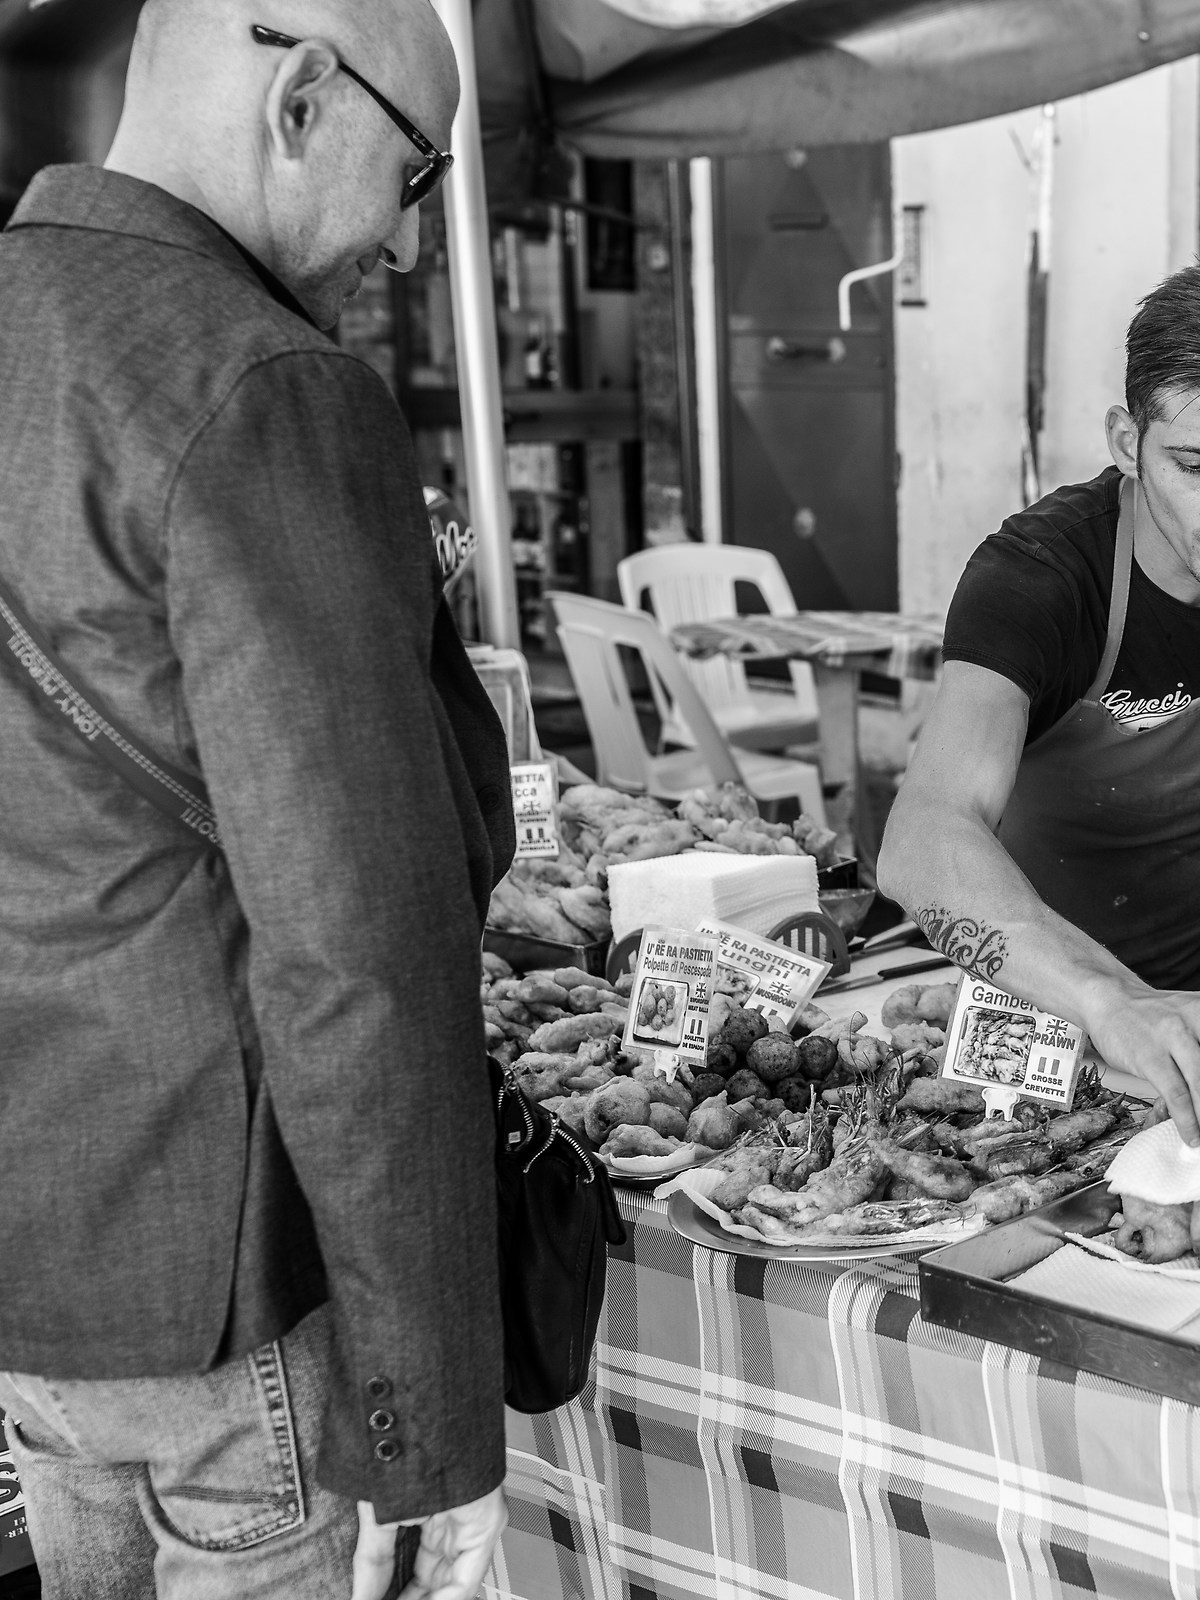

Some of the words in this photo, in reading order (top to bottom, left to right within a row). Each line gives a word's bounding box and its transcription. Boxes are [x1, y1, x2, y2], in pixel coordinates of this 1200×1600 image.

[666, 945, 677, 958] RA
[679, 947, 713, 962] PASTIETTA
[719, 944, 790, 979] unghi
[731, 940, 748, 952] RA
[749, 947, 811, 977] PASTIETTA
[643, 957, 669, 973] Polpette
[670, 960, 678, 973] di
[755, 987, 798, 1009] MUSHROOMS
[972, 986, 1045, 1013] Gamber
[1033, 1032, 1076, 1051] PRAWN
[1031, 1074, 1063, 1087] GROSSE
[1024, 1083, 1066, 1098] CREVETTE
